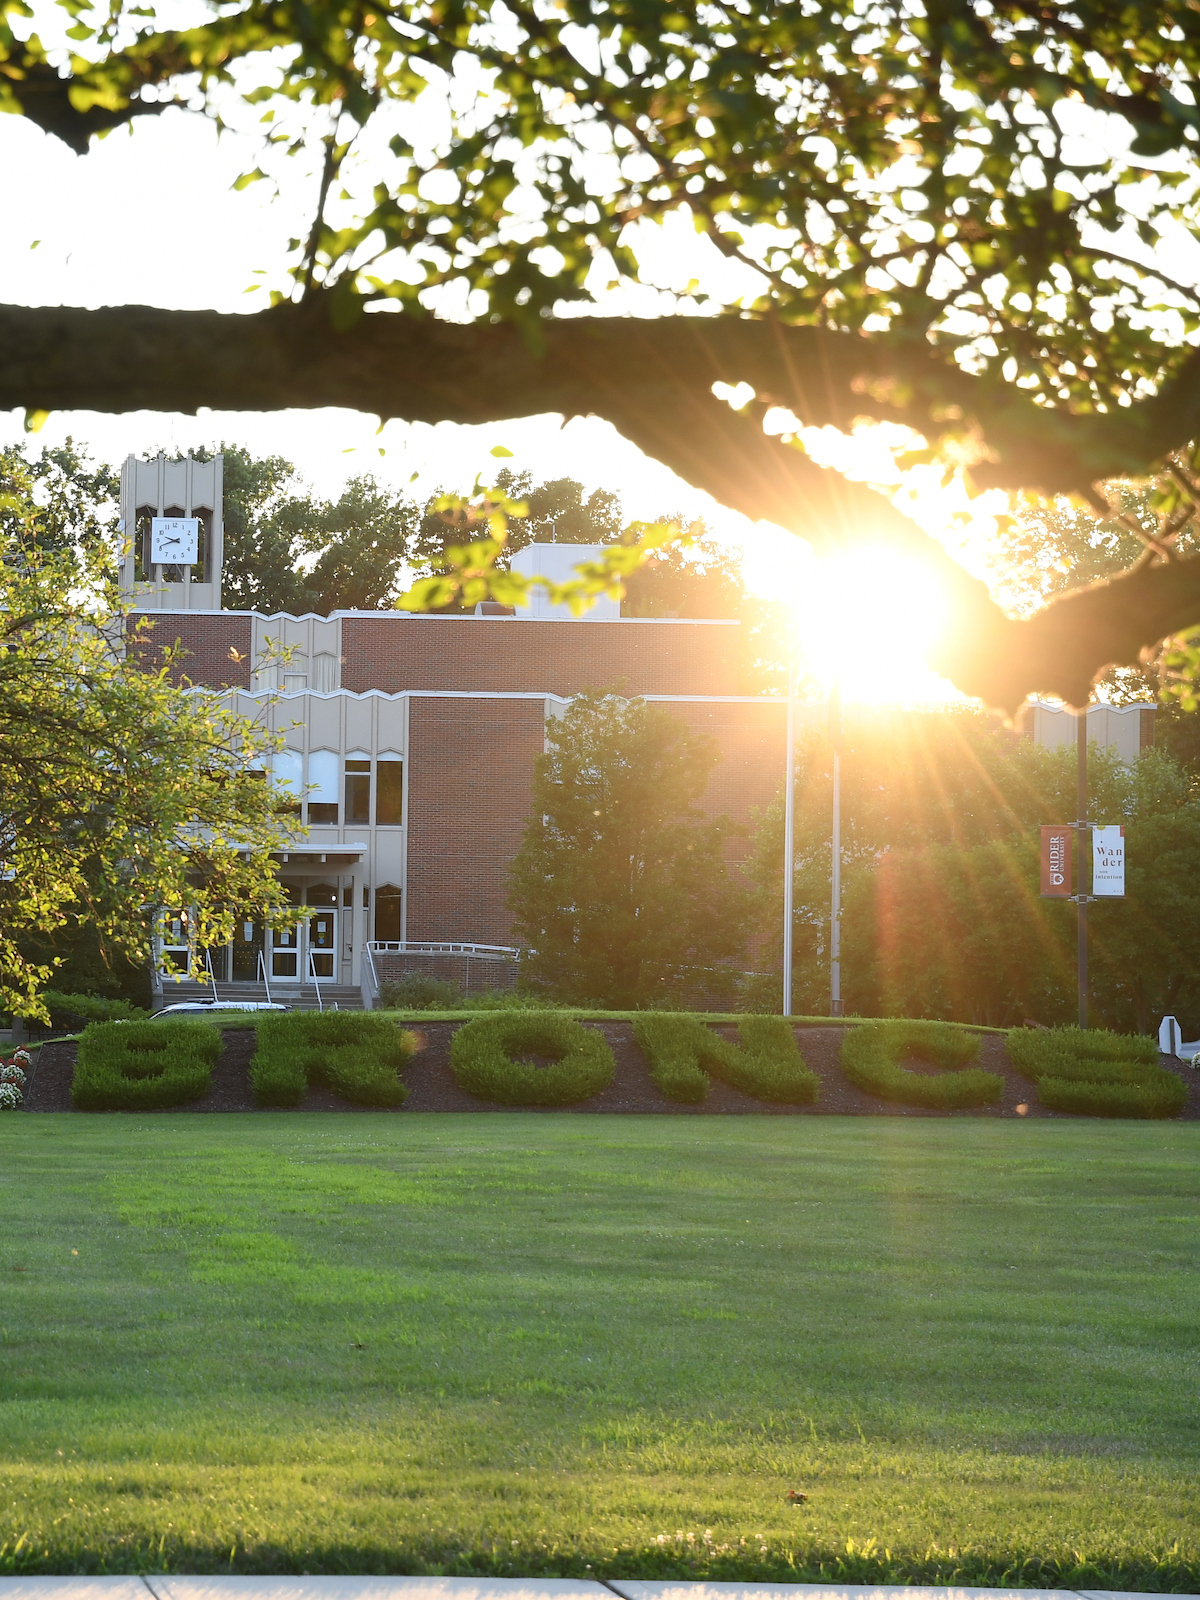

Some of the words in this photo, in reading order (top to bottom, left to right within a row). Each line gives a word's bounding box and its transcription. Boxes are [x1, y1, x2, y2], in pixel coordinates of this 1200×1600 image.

[1050, 836, 1059, 871] RIDER
[1097, 847, 1122, 856] Wan
[1102, 858, 1122, 866] der
[71, 1010, 1188, 1120] BRONCS
